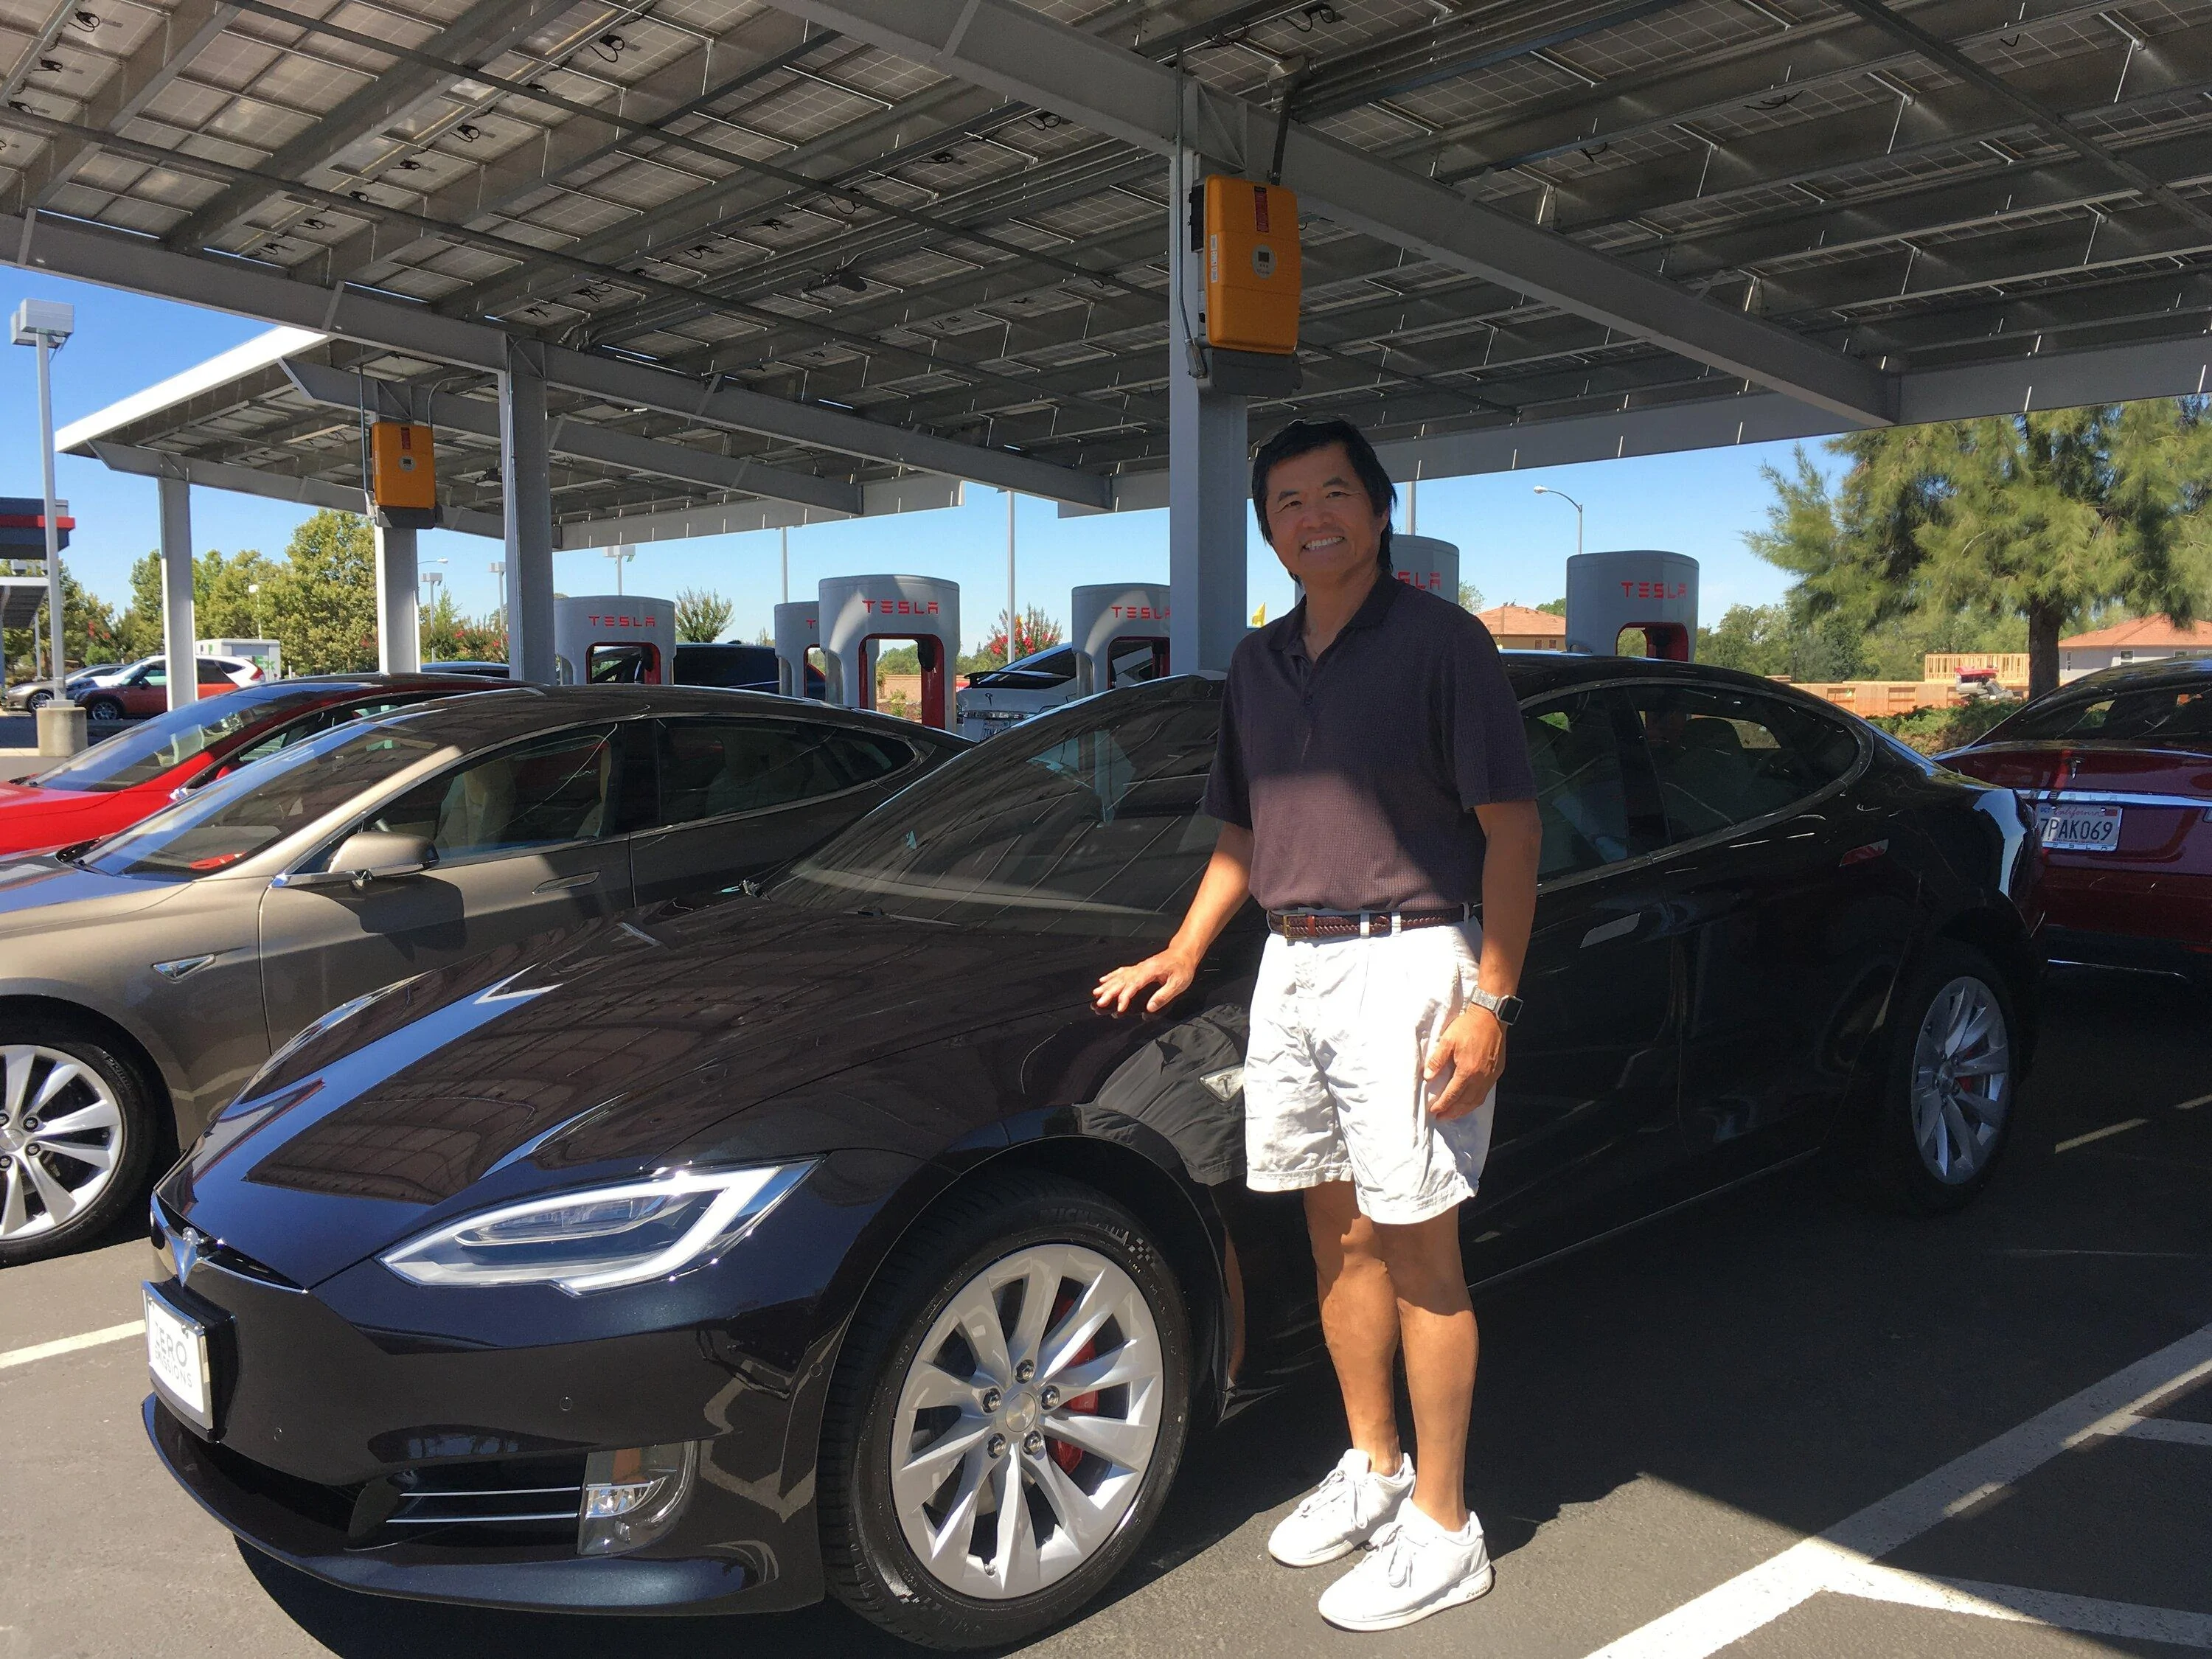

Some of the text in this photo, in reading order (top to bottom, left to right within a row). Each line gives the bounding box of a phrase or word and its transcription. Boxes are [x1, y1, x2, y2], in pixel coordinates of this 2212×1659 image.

[1398, 571, 1441, 590] SLA
[1620, 581, 1686, 599] TESLA
[861, 599, 939, 614] TESLA
[1110, 606, 1171, 619] TESLA
[588, 616, 655, 627] TESLA
[2039, 818, 2113, 841] 7PAK069
[155, 1321, 187, 1367] ZERO
[154, 1345, 192, 1388] EMISSIONS
